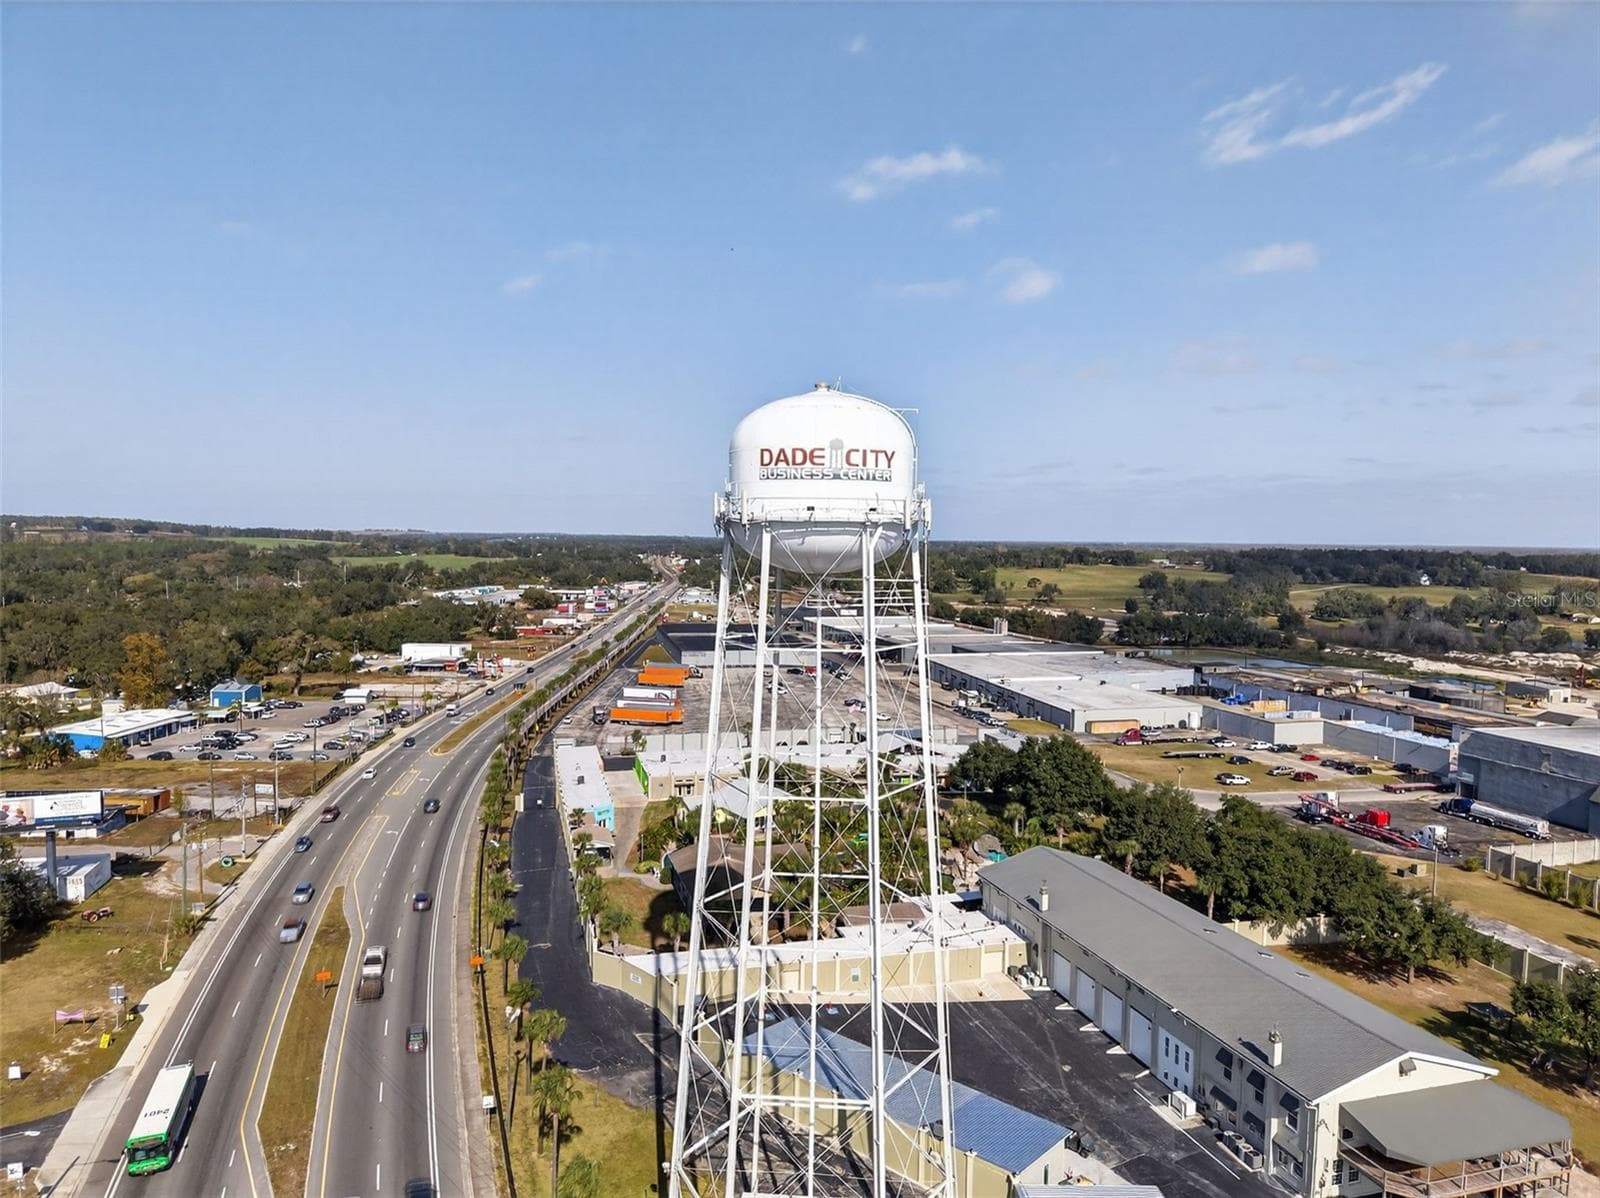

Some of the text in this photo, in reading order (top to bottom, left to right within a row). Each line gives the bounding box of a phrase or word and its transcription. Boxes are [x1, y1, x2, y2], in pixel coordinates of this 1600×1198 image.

[760, 447, 896, 468] DADE CITY
[759, 468, 892, 482] BUSINESS CENTER
